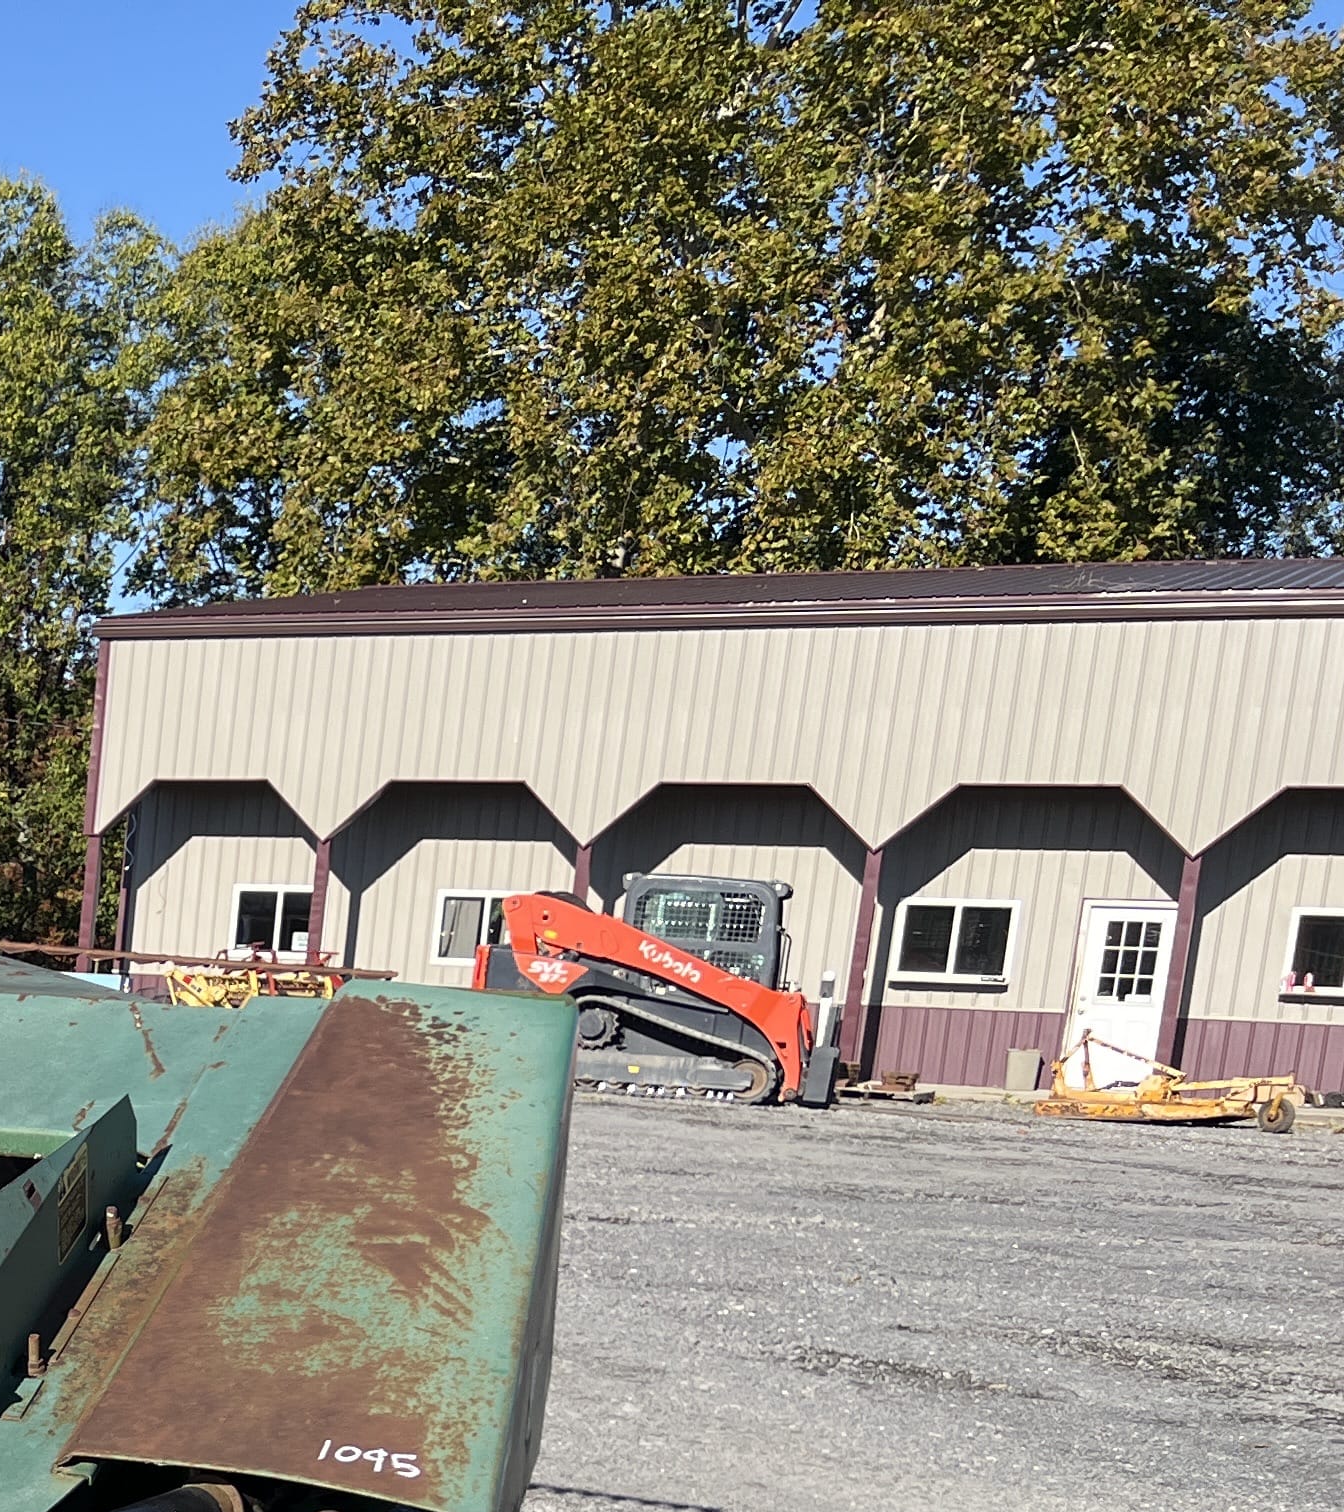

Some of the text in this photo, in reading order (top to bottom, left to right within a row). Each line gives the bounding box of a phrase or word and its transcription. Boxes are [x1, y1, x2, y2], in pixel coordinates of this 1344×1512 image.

[527, 960, 569, 975] SVL
[638, 940, 701, 984] Kubota
[317, 1438, 422, 1479] 1095
